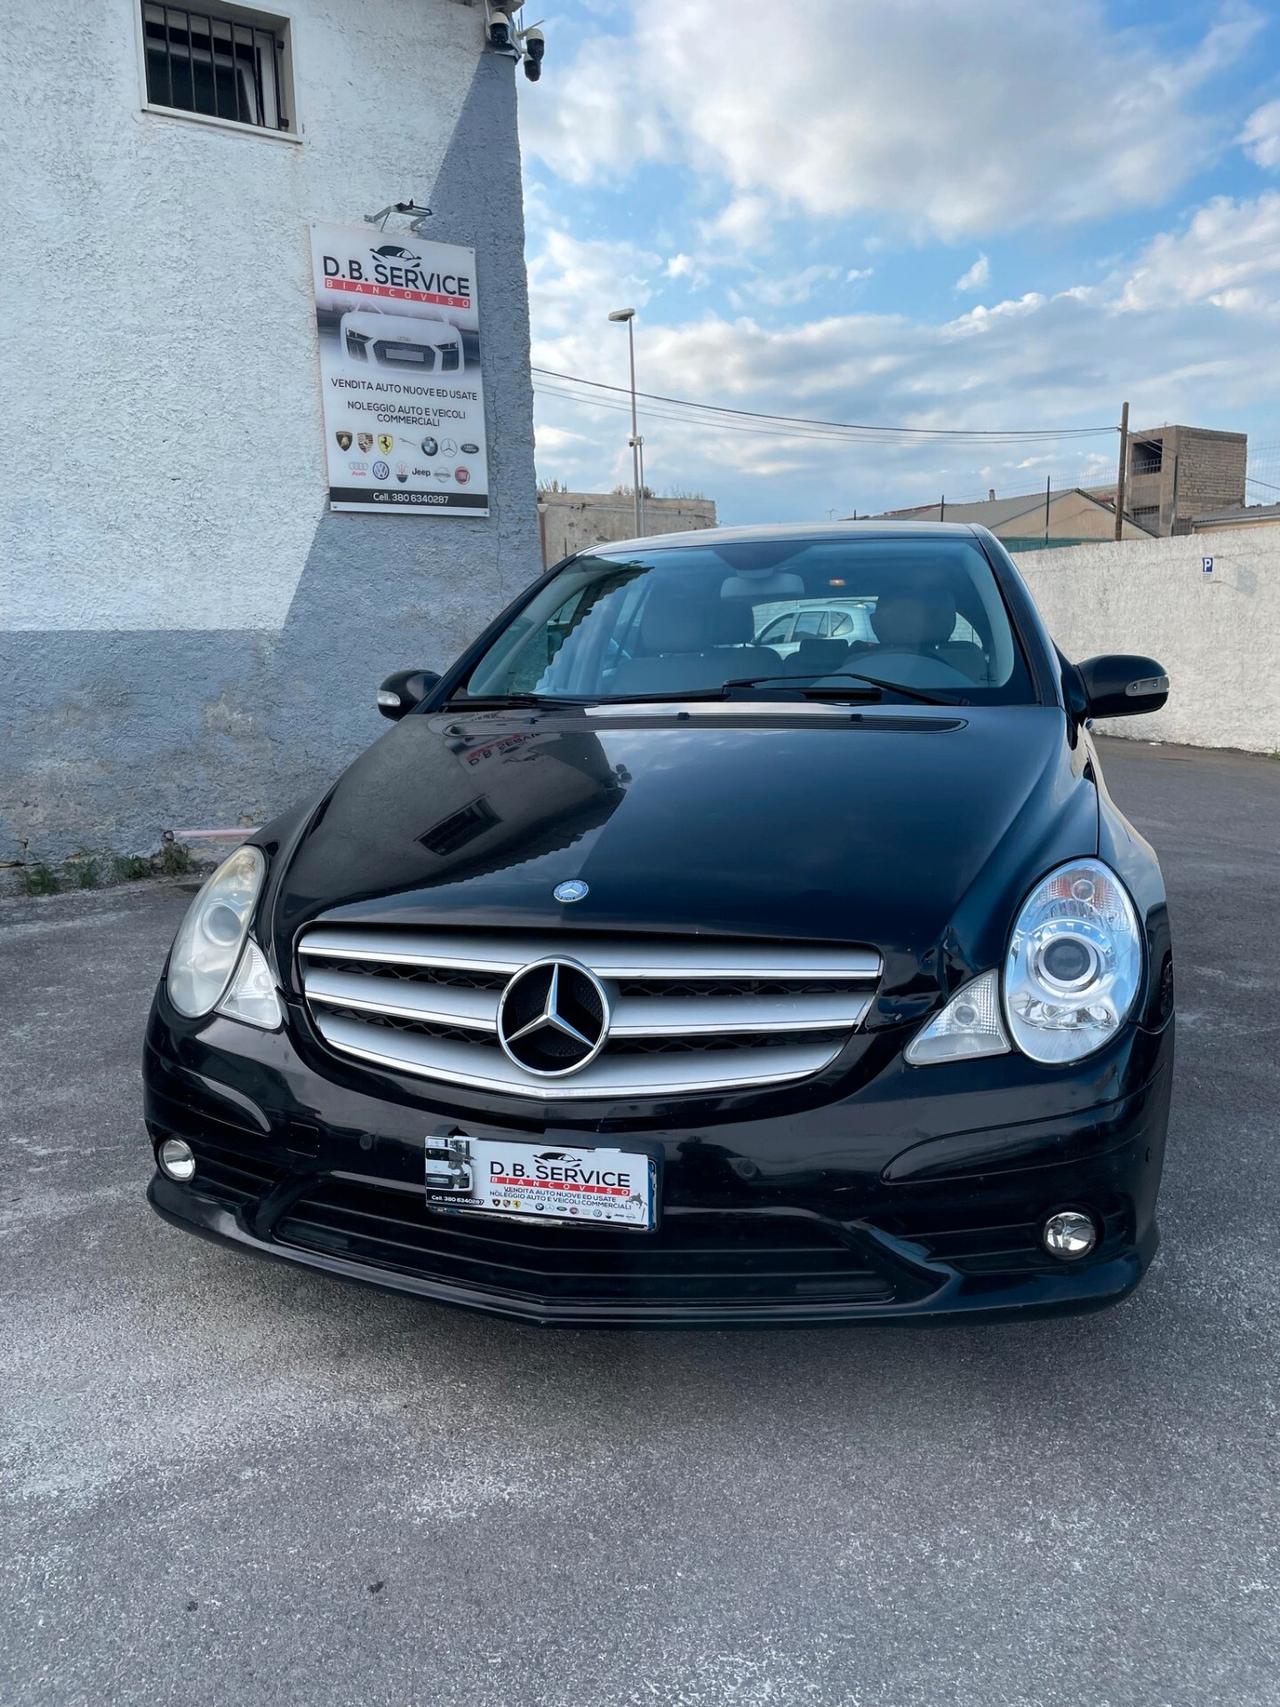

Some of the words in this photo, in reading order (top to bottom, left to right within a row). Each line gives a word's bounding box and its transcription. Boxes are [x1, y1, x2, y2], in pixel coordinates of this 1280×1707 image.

[322, 255, 369, 282] D.B.
[374, 264, 470, 297] SERVICE
[326, 279, 470, 308] BIANCOVISO
[331, 378, 374, 391] VENDITA
[375, 381, 402, 394] AUTO
[403, 385, 436, 397] NUOVE
[436, 389, 448, 398] ED
[449, 390, 478, 401] USATE
[347, 401, 396, 413] NOLEGGIO
[397, 405, 424, 416] AUTO
[424, 407, 430, 417] E
[431, 408, 466, 420] VEICOLI
[377, 413, 440, 427] COMMERCIALI
[411, 468, 431, 477] Jeep
[373, 492, 391, 502] Cell.
[391, 493, 410, 503] 380
[410, 494, 449, 504] 6340287
[1203, 558, 1212, 572] P
[490, 1161, 530, 1178] D.B.
[535, 1165, 631, 1188] SERVICE
[491, 1176, 629, 1196] BIANCOVISO
[504, 1186, 534, 1194] VENDITA
[556, 1191, 581, 1199] NUOVE
[490, 1190, 526, 1199] NOLEGGIO
[552, 1197, 580, 1205] VEICOLI
[581, 1199, 632, 1210] COMMERCIALI
